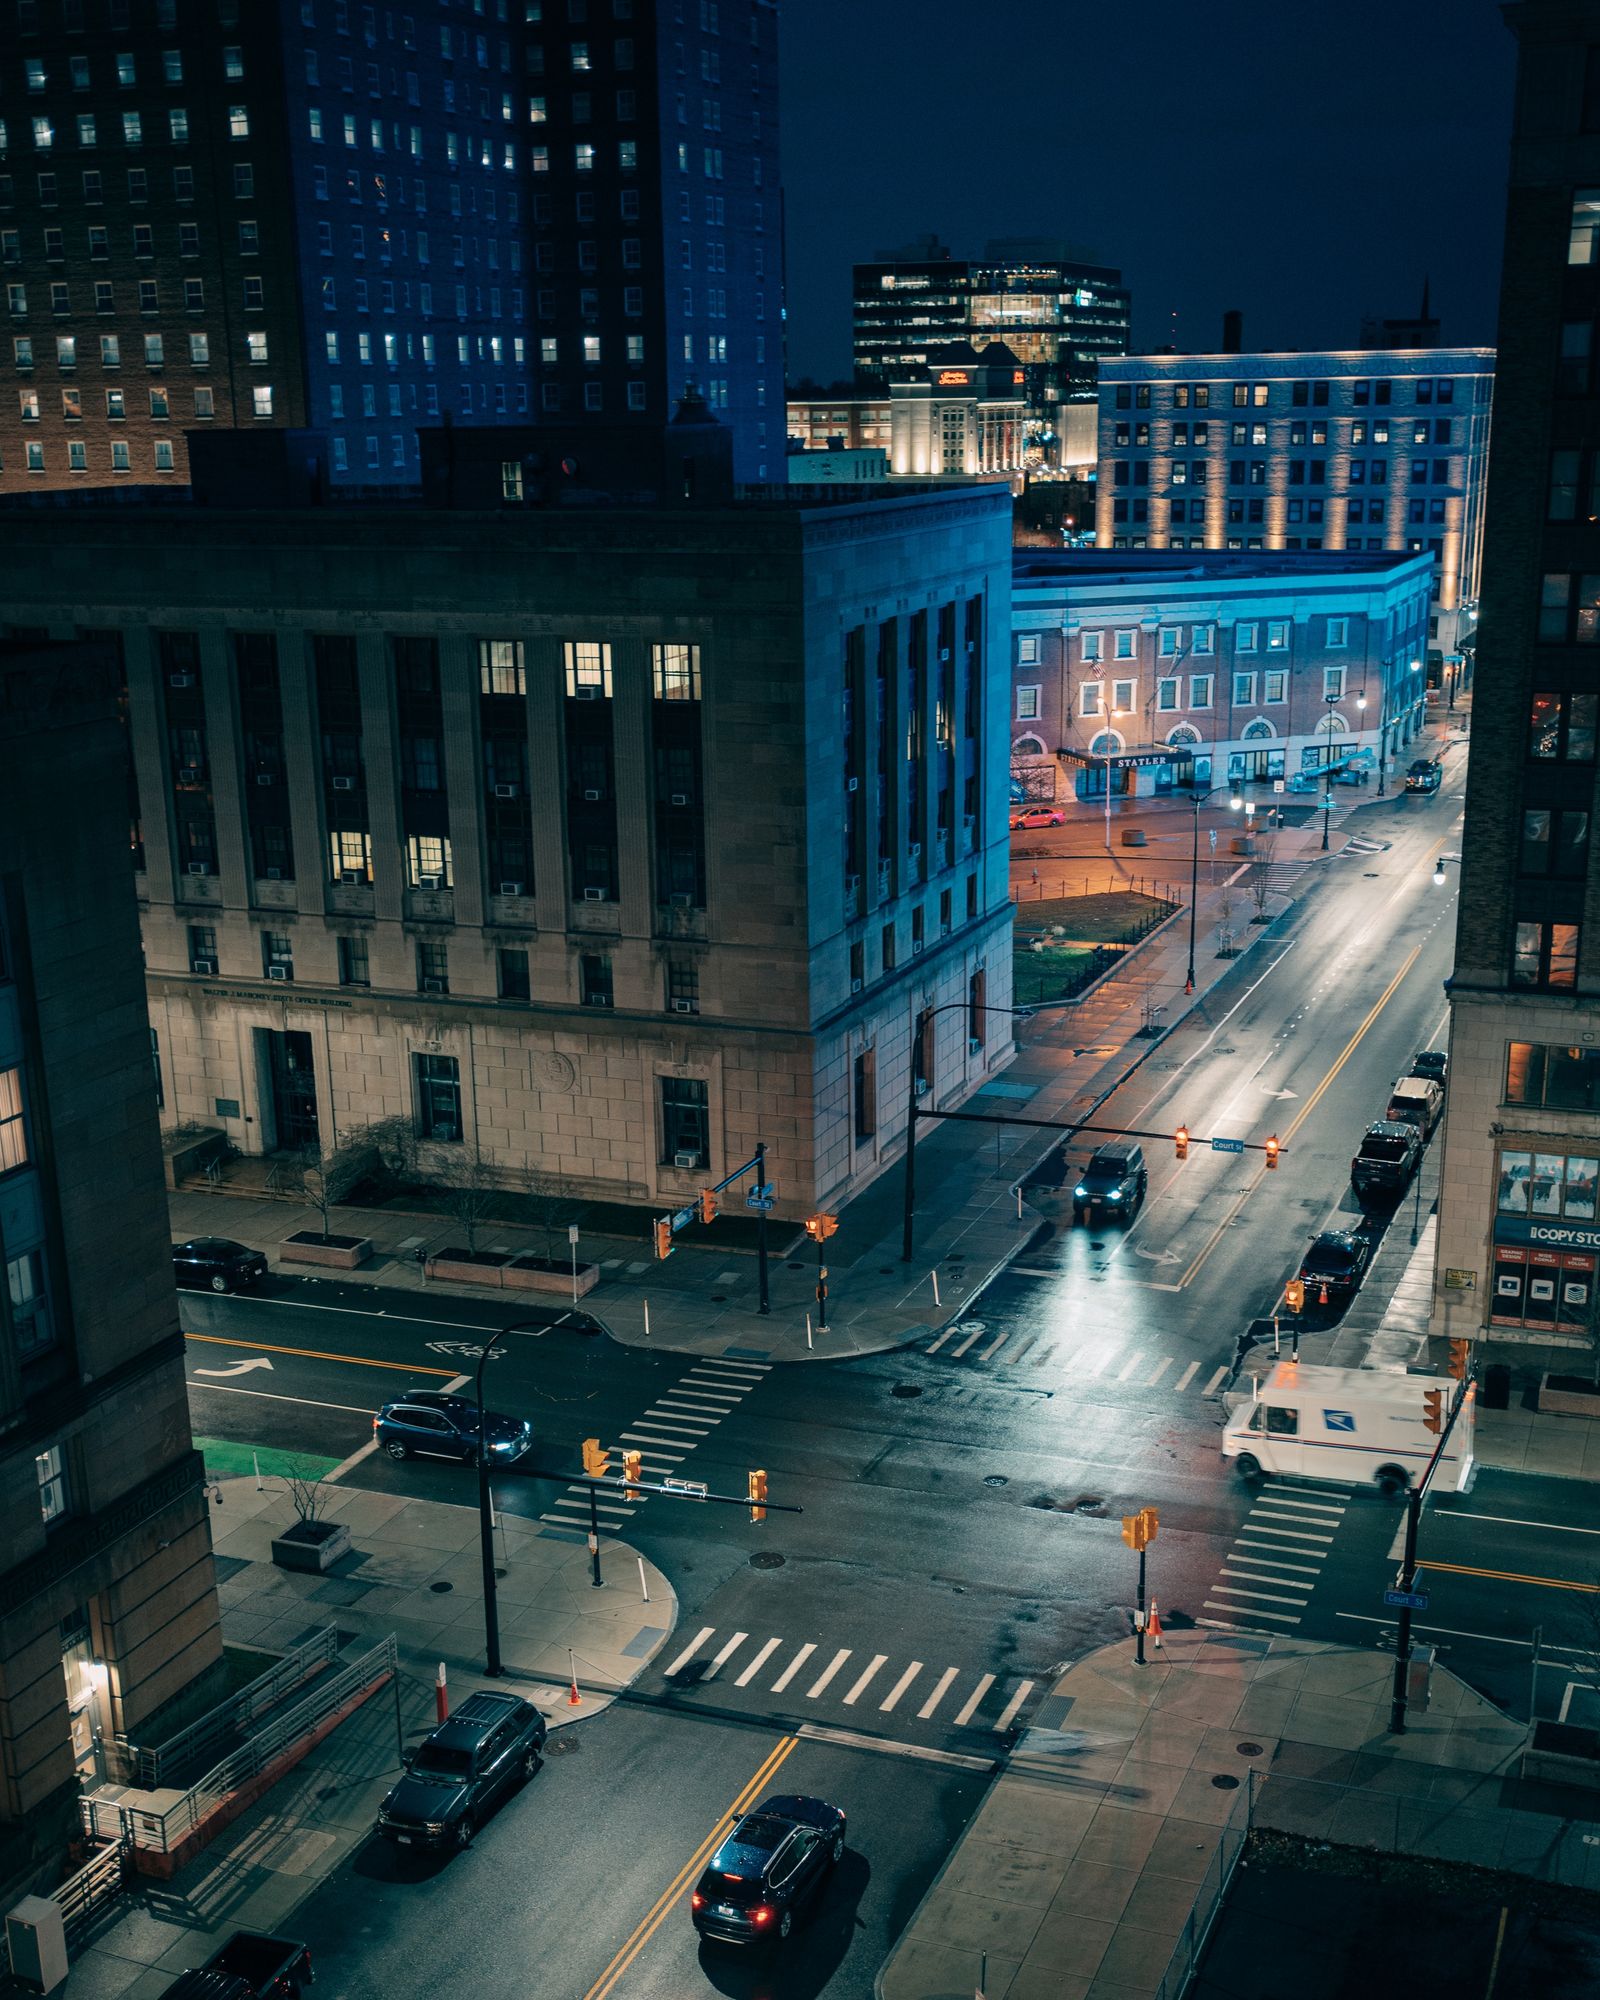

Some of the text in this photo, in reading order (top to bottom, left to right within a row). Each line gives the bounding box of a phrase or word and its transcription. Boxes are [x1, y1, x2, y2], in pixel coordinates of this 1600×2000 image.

[1118, 757, 1166, 768] STATLER
[1213, 1140, 1234, 1149] Court
[1537, 1228, 1576, 1242] COPY
[1388, 1594, 1423, 1606] Court St
